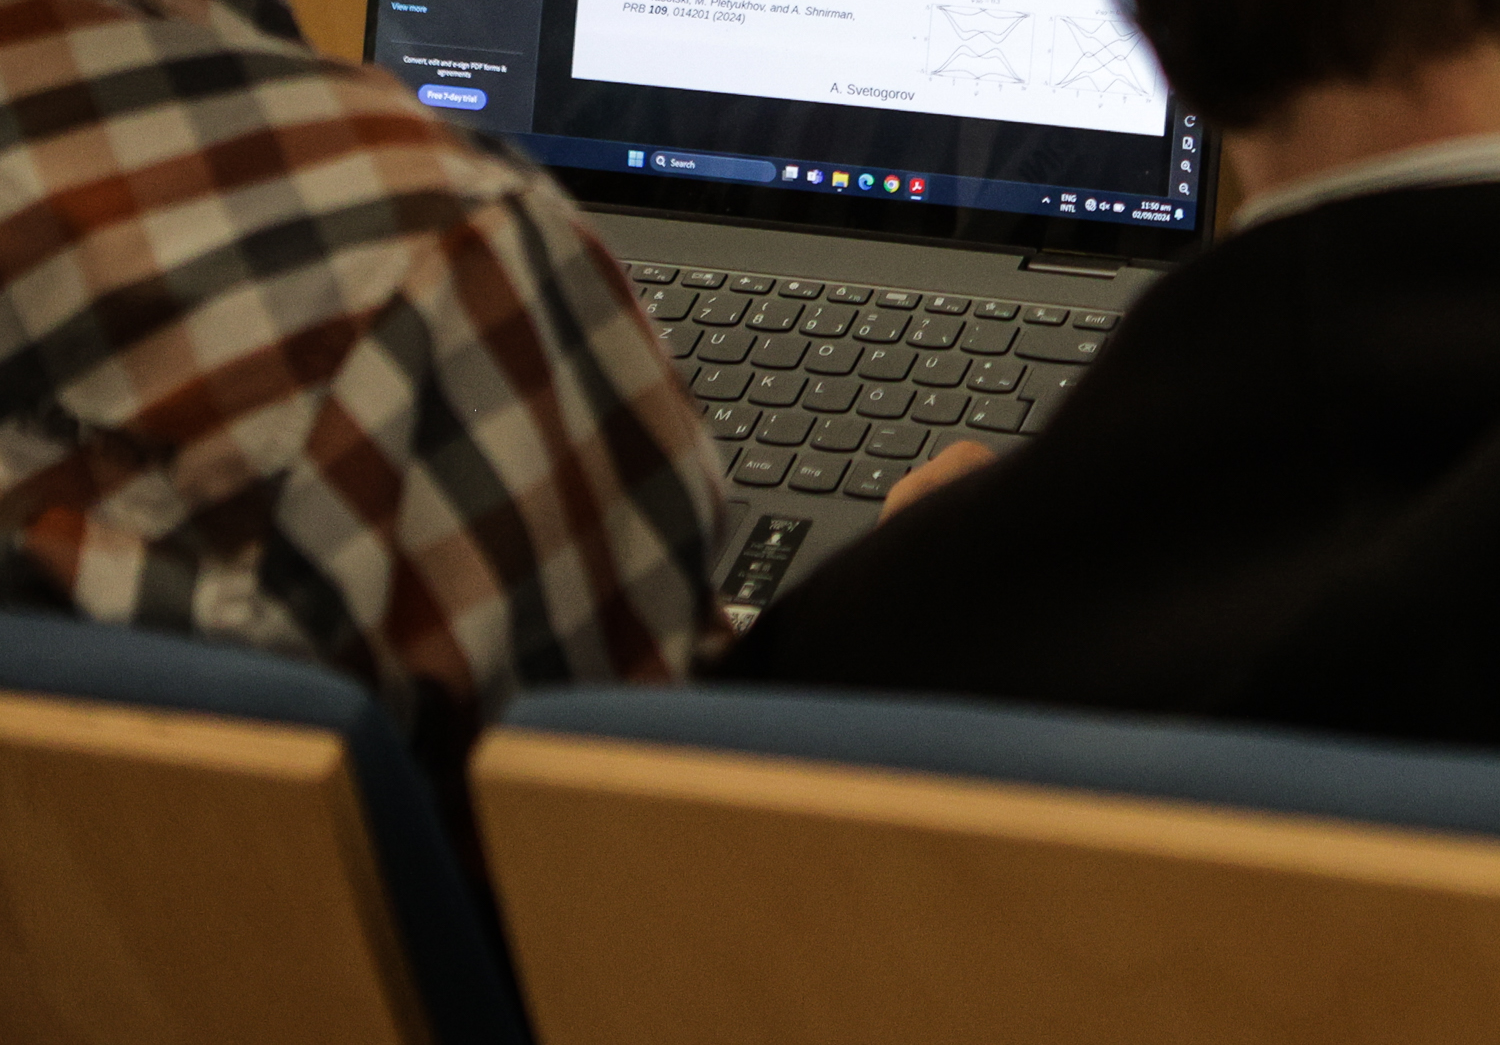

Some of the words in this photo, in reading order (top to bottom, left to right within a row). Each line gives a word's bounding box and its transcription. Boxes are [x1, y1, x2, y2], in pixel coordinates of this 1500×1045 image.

[391, 2, 408, 12] View
[409, 5, 428, 14] more
[622, 2, 646, 14] PRB
[648, 5, 670, 17] 109,
[673, 7, 710, 21] 014201
[712, 11, 746, 24] (2024)
[770, 3, 790, 14] and
[792, 5, 802, 15] A.
[804, 7, 856, 21] Shnirman,
[830, 83, 843, 94] A.
[847, 84, 915, 102] Svetogorov
[670, 159, 695, 169] Search
[1061, 193, 1077, 203] ENG
[1060, 203, 1076, 213] INTL
[1141, 201, 1159, 211] 11:50
[1132, 211, 1171, 222] 02/09/2024
